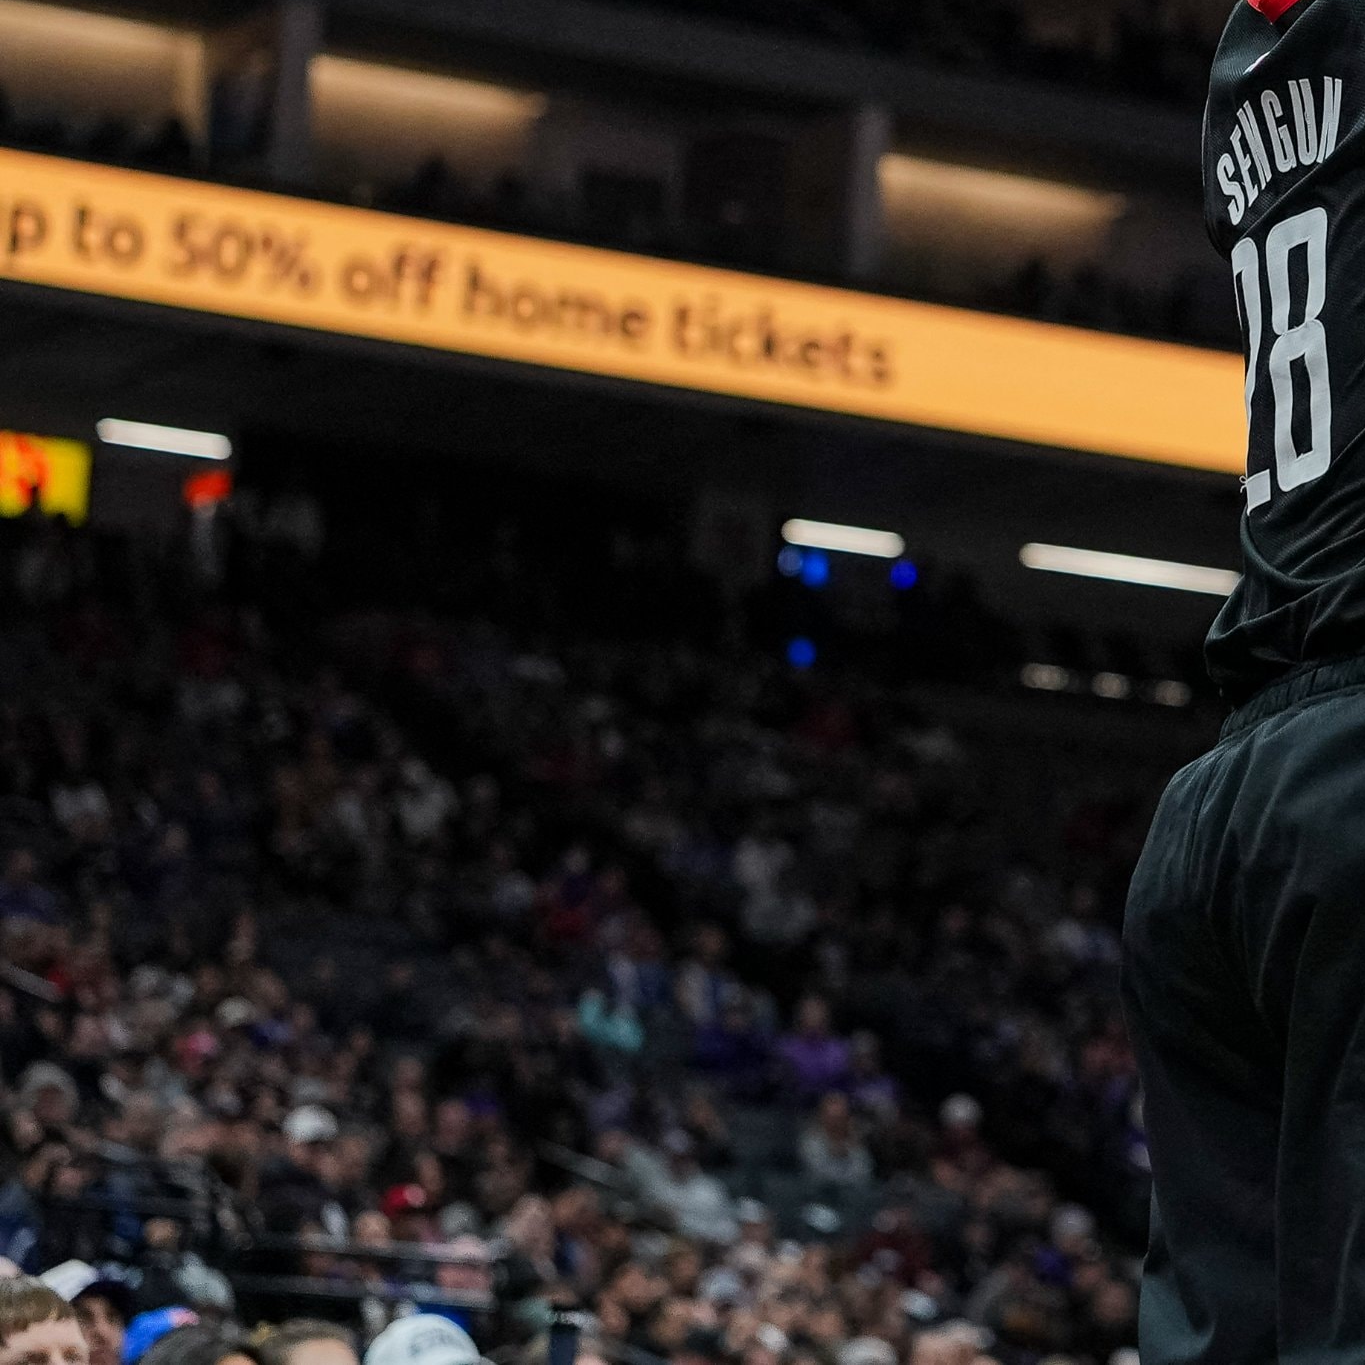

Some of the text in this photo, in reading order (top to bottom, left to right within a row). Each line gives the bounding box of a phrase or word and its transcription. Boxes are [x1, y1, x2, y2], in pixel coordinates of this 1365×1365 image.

[1216, 76, 1343, 227] SENGUN
[74, 198, 147, 267] to
[166, 210, 324, 301] 50%
[340, 243, 446, 315] off
[461, 258, 651, 346] home
[674, 292, 895, 391] tickets
[1230, 206, 1333, 515] 28
